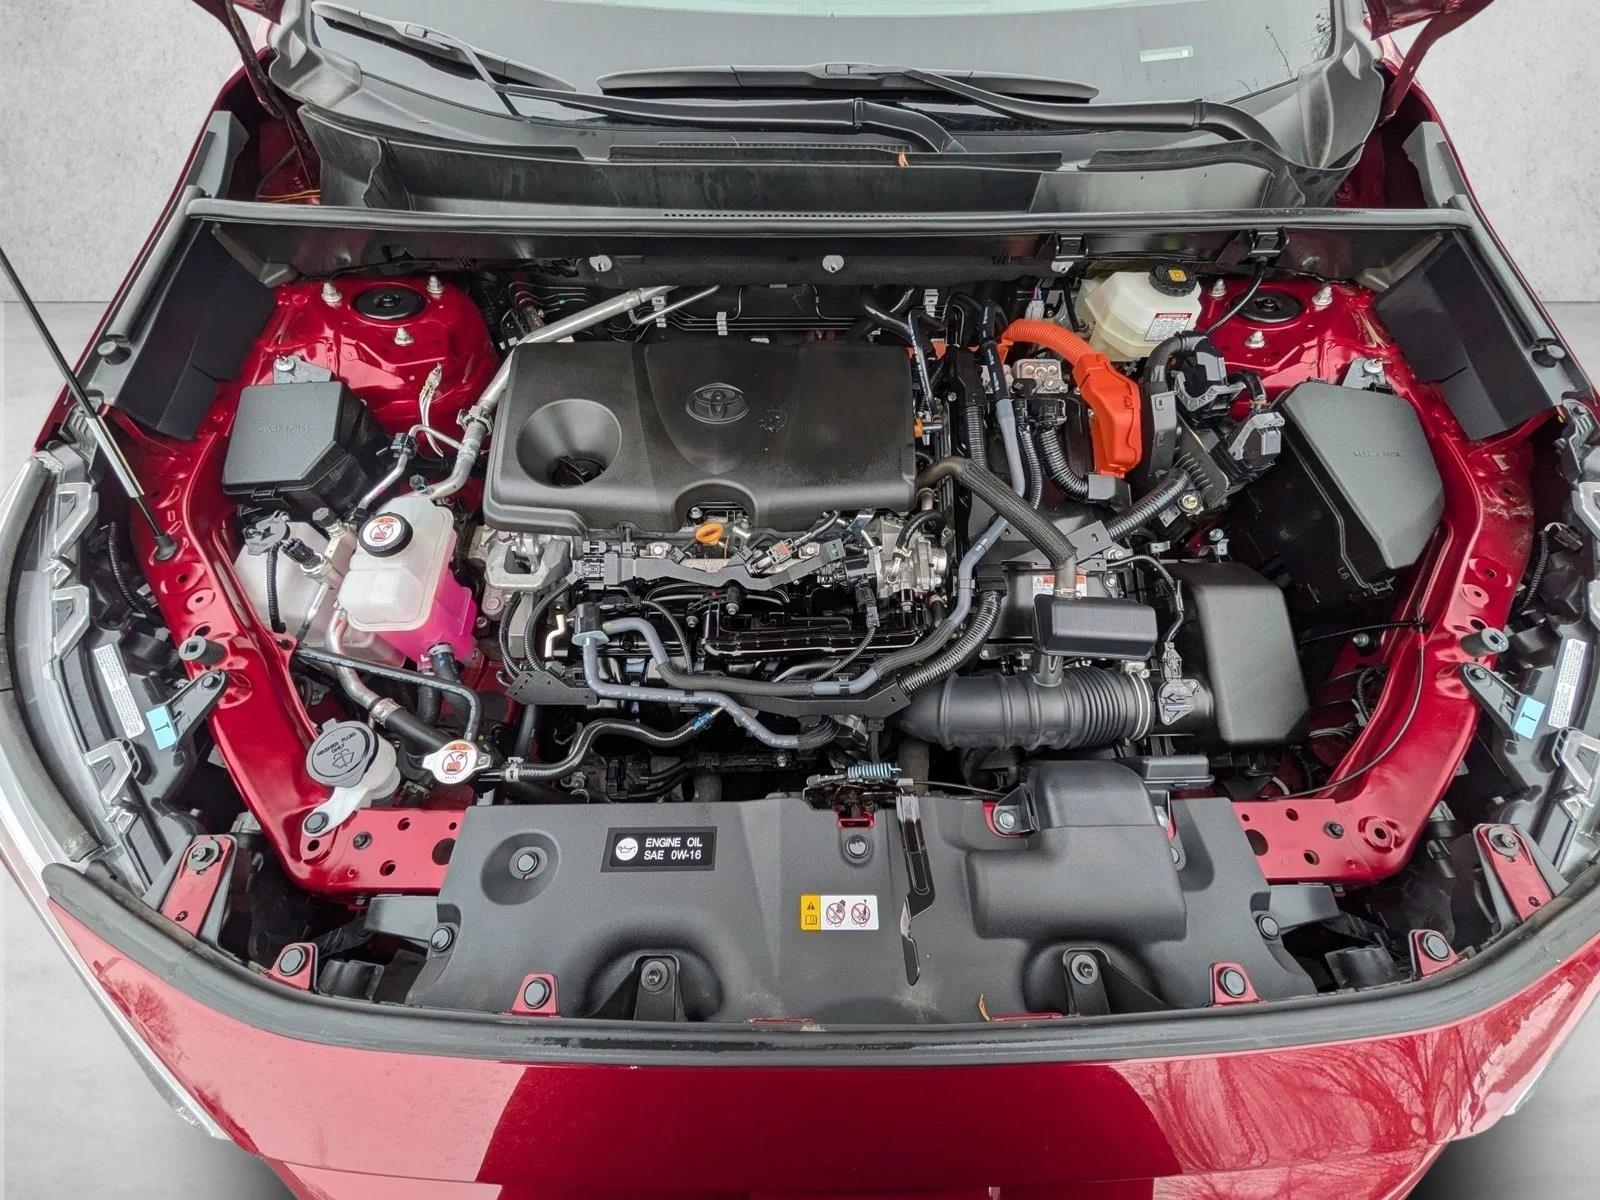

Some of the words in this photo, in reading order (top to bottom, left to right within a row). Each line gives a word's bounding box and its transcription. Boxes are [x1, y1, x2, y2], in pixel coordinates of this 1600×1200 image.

[1521, 712, 1537, 722] T
[155, 721, 171, 732] T
[316, 741, 339, 756] WASHER
[341, 731, 356, 742] FLUID
[331, 742, 345, 753] ONLY
[645, 837, 681, 848] ENGINE
[687, 837, 703, 847] OIL
[643, 850, 664, 860] SAE
[670, 850, 702, 860] 0W-16
